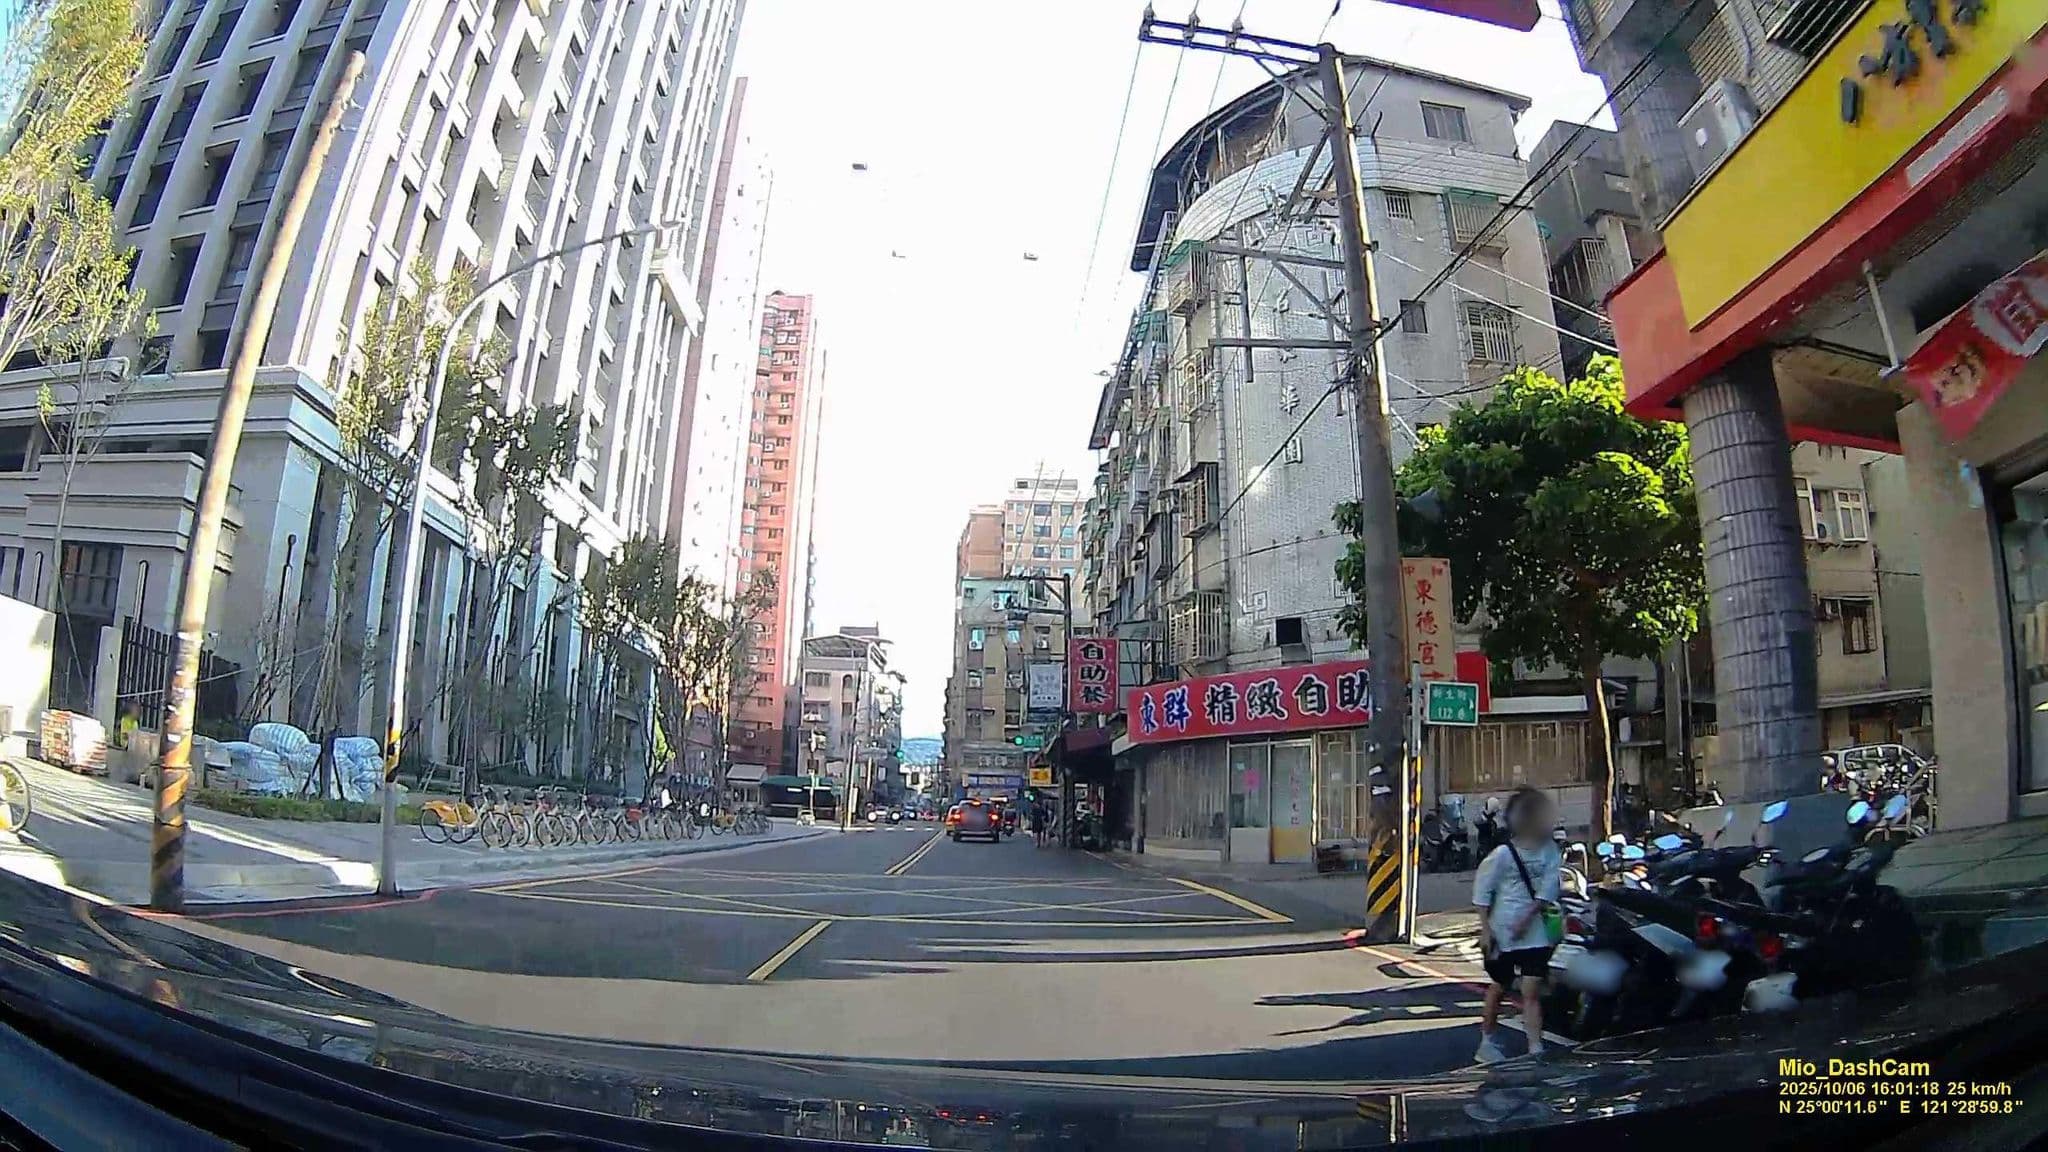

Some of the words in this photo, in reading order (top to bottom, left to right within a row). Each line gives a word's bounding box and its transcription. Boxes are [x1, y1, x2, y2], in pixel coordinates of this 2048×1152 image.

[1415, 579, 1439, 666] 東德宮
[1079, 642, 1109, 706] 自助餐
